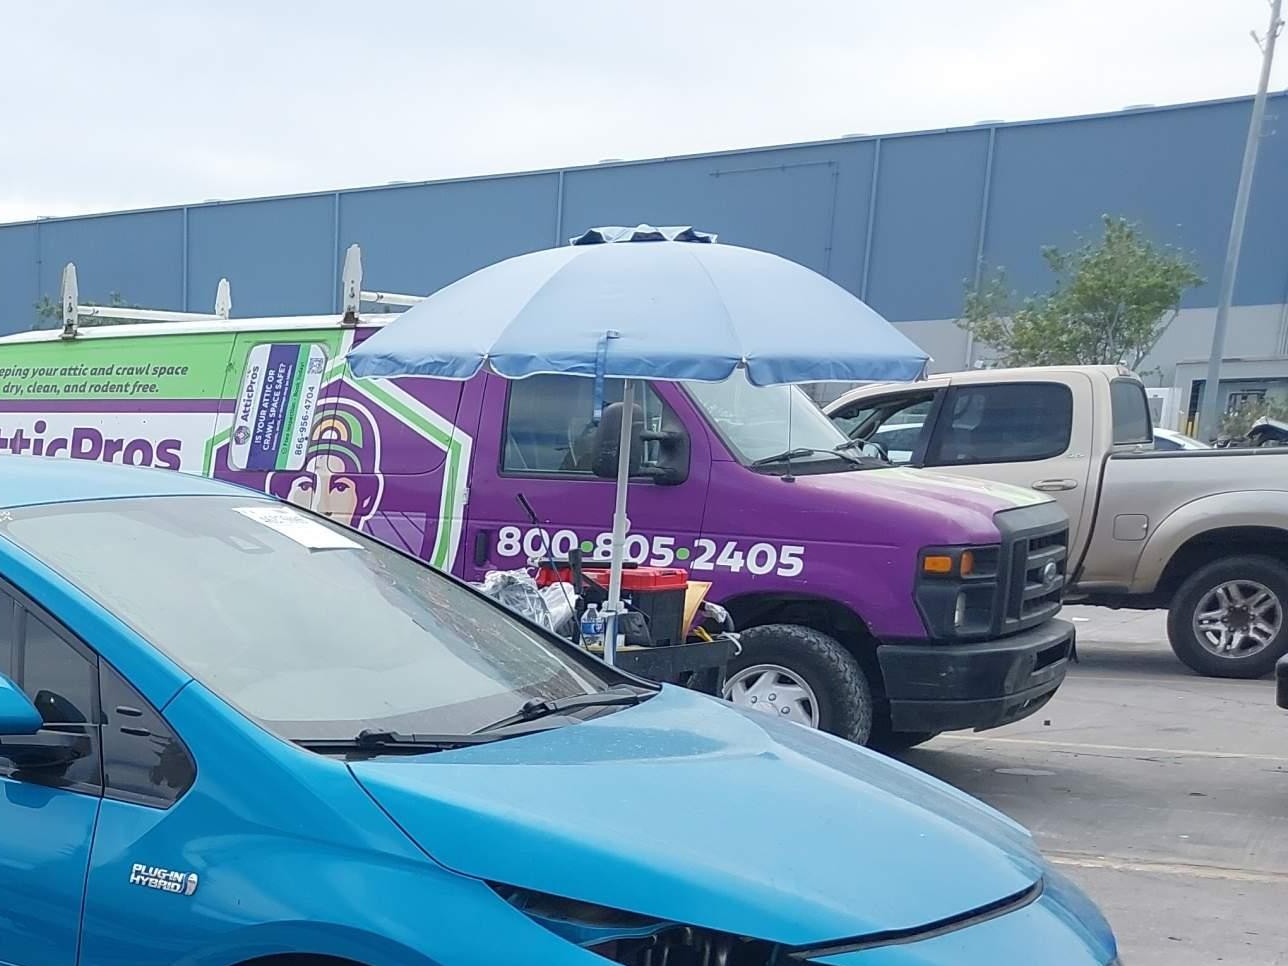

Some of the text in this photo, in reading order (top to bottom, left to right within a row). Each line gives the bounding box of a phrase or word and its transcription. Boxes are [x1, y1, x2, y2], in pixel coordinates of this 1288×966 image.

[2, 380, 160, 395] dry, clean, and rodent free.
[31, 367, 59, 379] your
[59, 363, 89, 377] attic
[90, 364, 115, 376] and
[115, 363, 151, 376] crawl
[152, 366, 189, 378] space
[241, 365, 260, 422] AtticPros
[255, 369, 276, 444] IS YOUR ATTIC OR
[262, 420, 274, 451] CRAWL
[269, 391, 281, 418] SPACE
[275, 363, 286, 390] SAFE?
[295, 386, 315, 456] 866-956-4704
[130, 874, 181, 893] HYBRID
